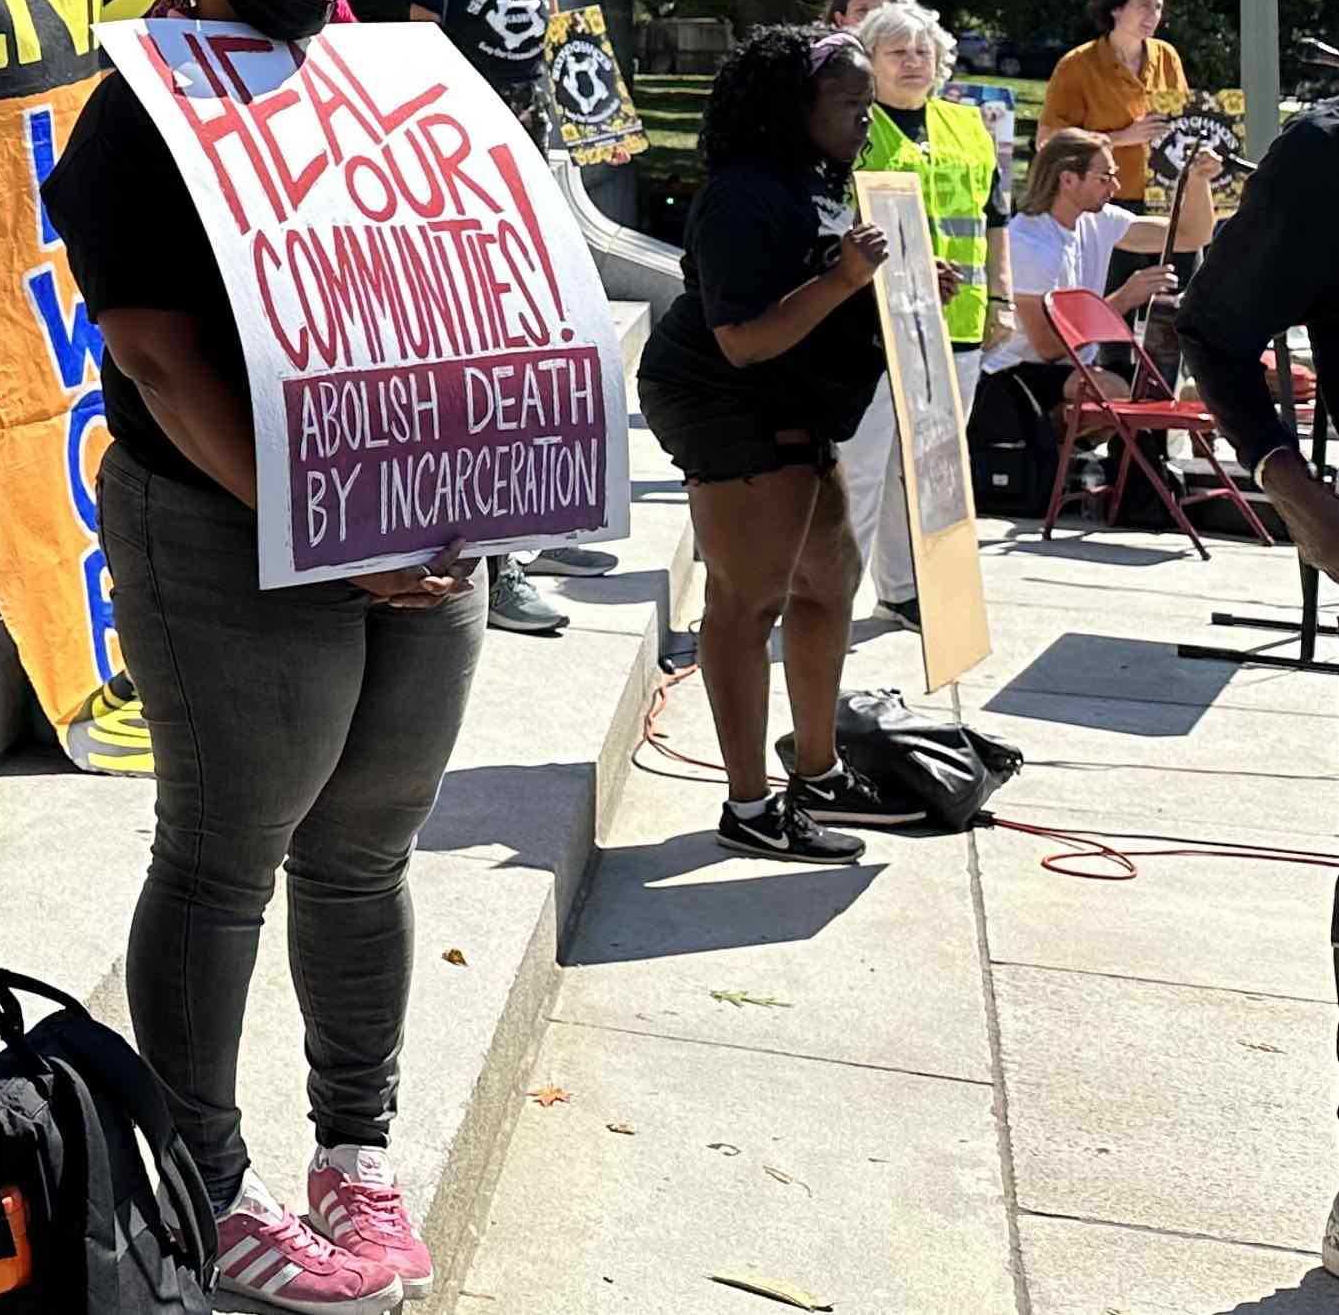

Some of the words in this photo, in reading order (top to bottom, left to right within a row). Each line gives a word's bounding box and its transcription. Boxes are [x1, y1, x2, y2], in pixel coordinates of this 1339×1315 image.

[136, 31, 449, 235] HEAL
[345, 113, 504, 223] OUR
[251, 144, 574, 372] COMMUNITIES!
[300, 371, 440, 461] ABOLISH
[464, 358, 595, 435] DEATH
[307, 462, 362, 547] BY
[379, 435, 598, 535] INCARCERATION
